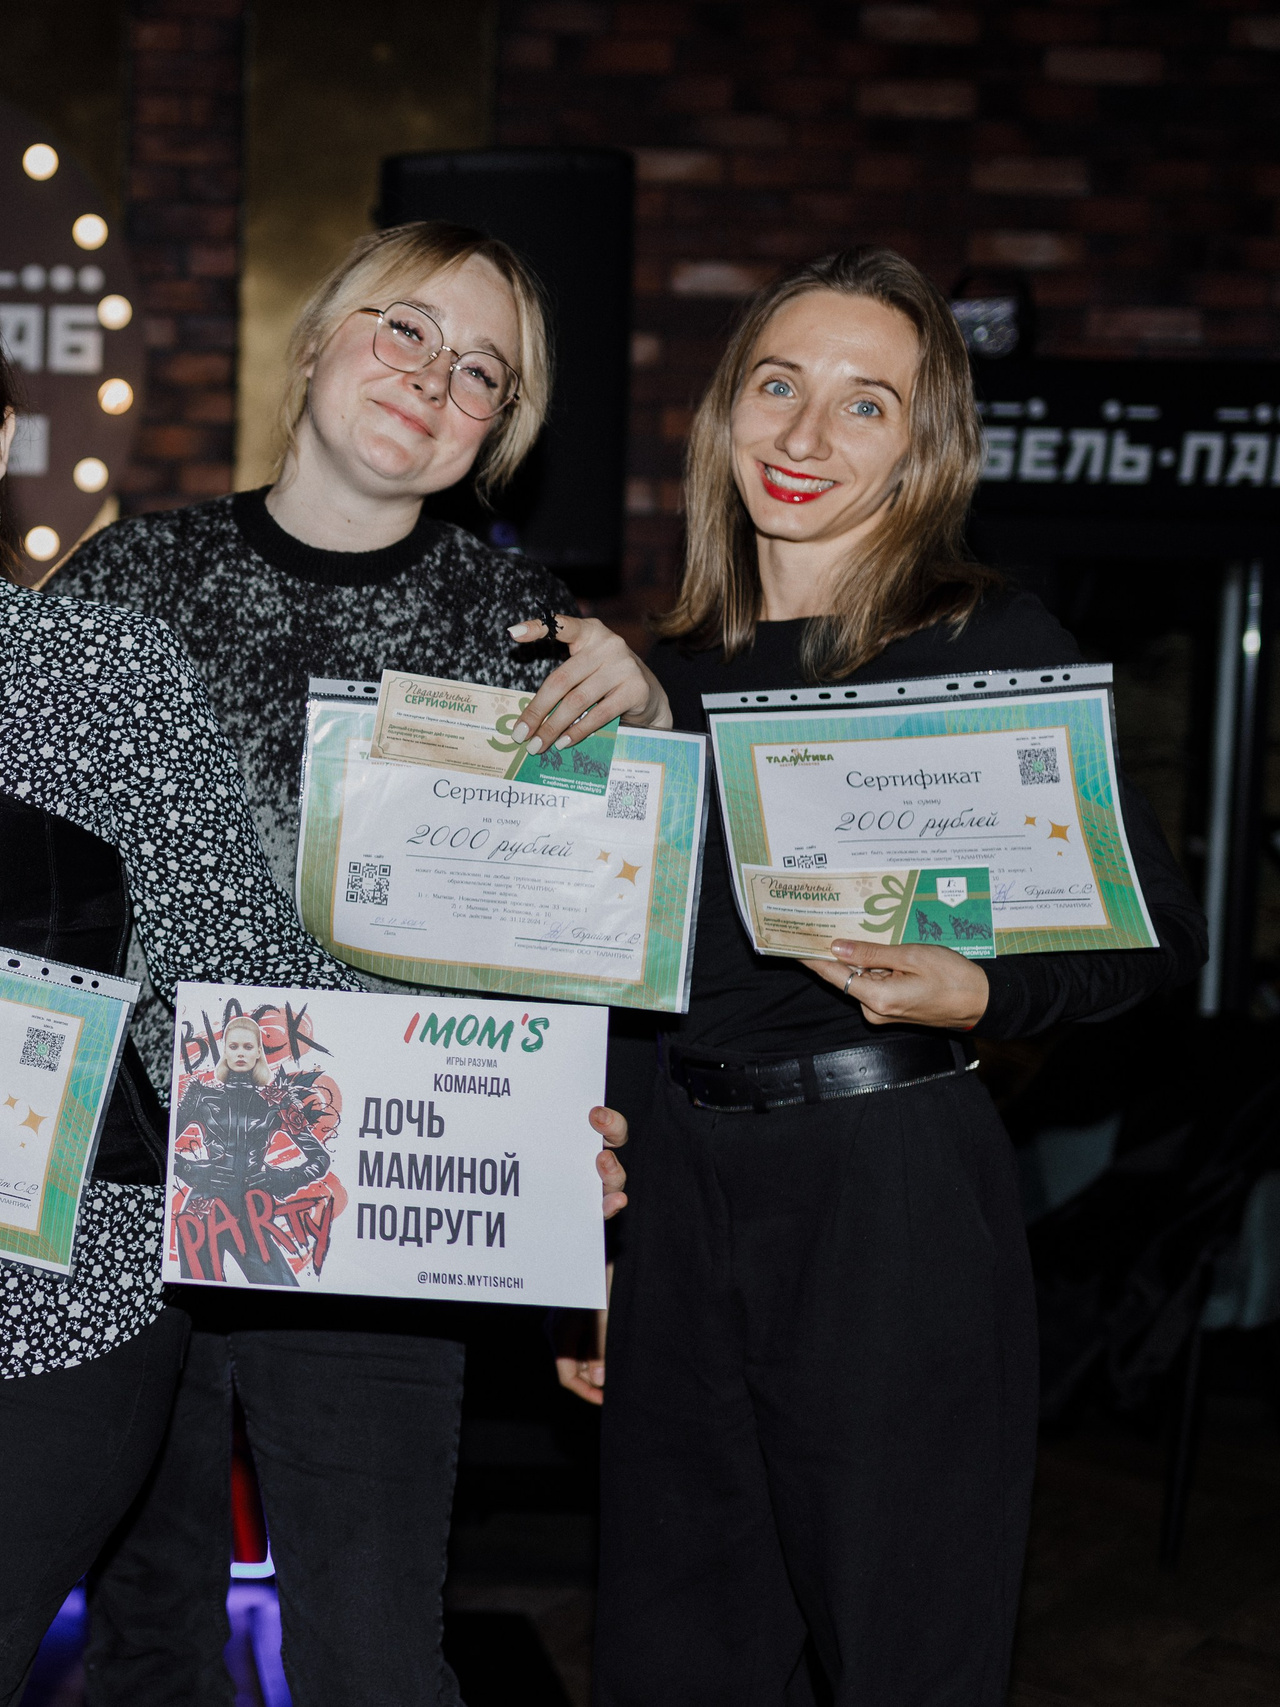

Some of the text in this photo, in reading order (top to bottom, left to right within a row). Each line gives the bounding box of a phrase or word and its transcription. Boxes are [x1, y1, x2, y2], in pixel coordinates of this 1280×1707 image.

[399, 680, 472, 703] Подарочный
[404, 694, 478, 714] СЕРТИФИКАТ
[766, 749, 834, 765] ТАЛАНТИКА
[846, 769, 982, 791] Сертификат
[433, 779, 570, 808] Сертификат
[497, 818, 521, 827] сумму
[835, 808, 1000, 837] 2000 рублей
[406, 824, 574, 861] 2000 рублей
[760, 875, 834, 892] Подарочный
[769, 889, 841, 902] СЕРТИФИКАТ
[446, 1056, 498, 1069] ИГРЫ РАЗУМА
[433, 1073, 511, 1098] КОМАНДА
[359, 1096, 445, 1138] ДОЧЬ
[357, 1150, 520, 1197] МАМИНОЙ
[177, 1189, 335, 1282] PARTY
[357, 1203, 505, 1248] ПОДРУГИ
[417, 1271, 524, 1290] @IMOMS.MYTISHCHI
